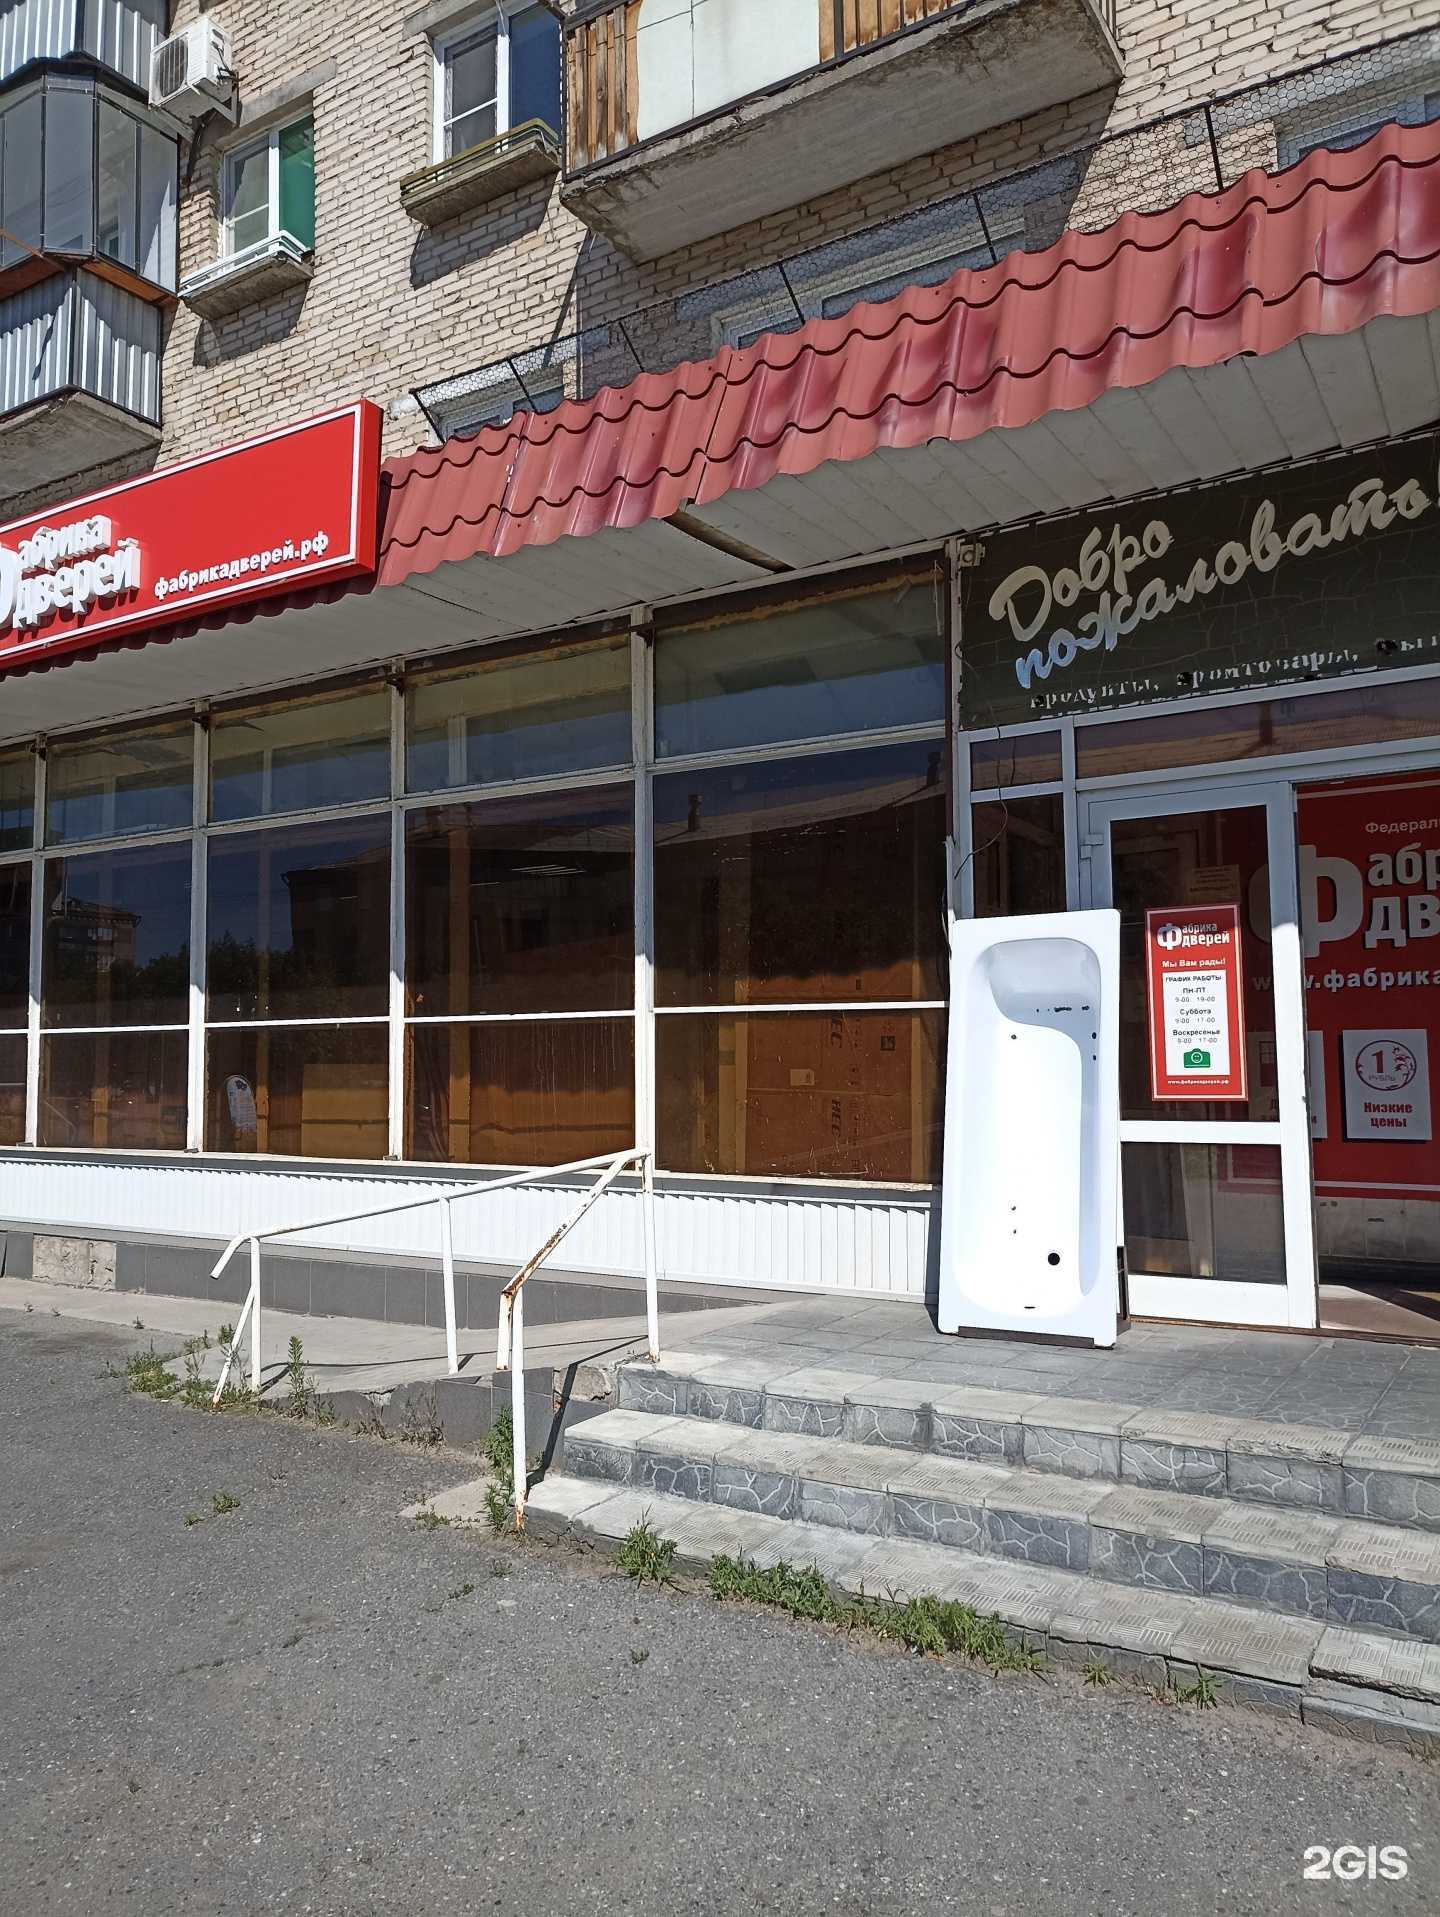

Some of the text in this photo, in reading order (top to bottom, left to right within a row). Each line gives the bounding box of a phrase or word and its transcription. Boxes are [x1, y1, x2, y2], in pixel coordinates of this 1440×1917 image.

[154, 530, 329, 600] фабрикадверей.рф
[988, 520, 1174, 642] Добро
[1015, 477, 1431, 689] пожаловать
[1182, 931, 1230, 948] дверей
[1161, 957, 1226, 968] Мы Вам рады!
[1179, 1008, 1212, 1016] Суббота
[1172, 1029, 1221, 1038] Воскресенье
[1371, 1049, 1384, 1074] 1
[1363, 1101, 1414, 1114] Низкие
[1370, 1117, 1408, 1129] цены
